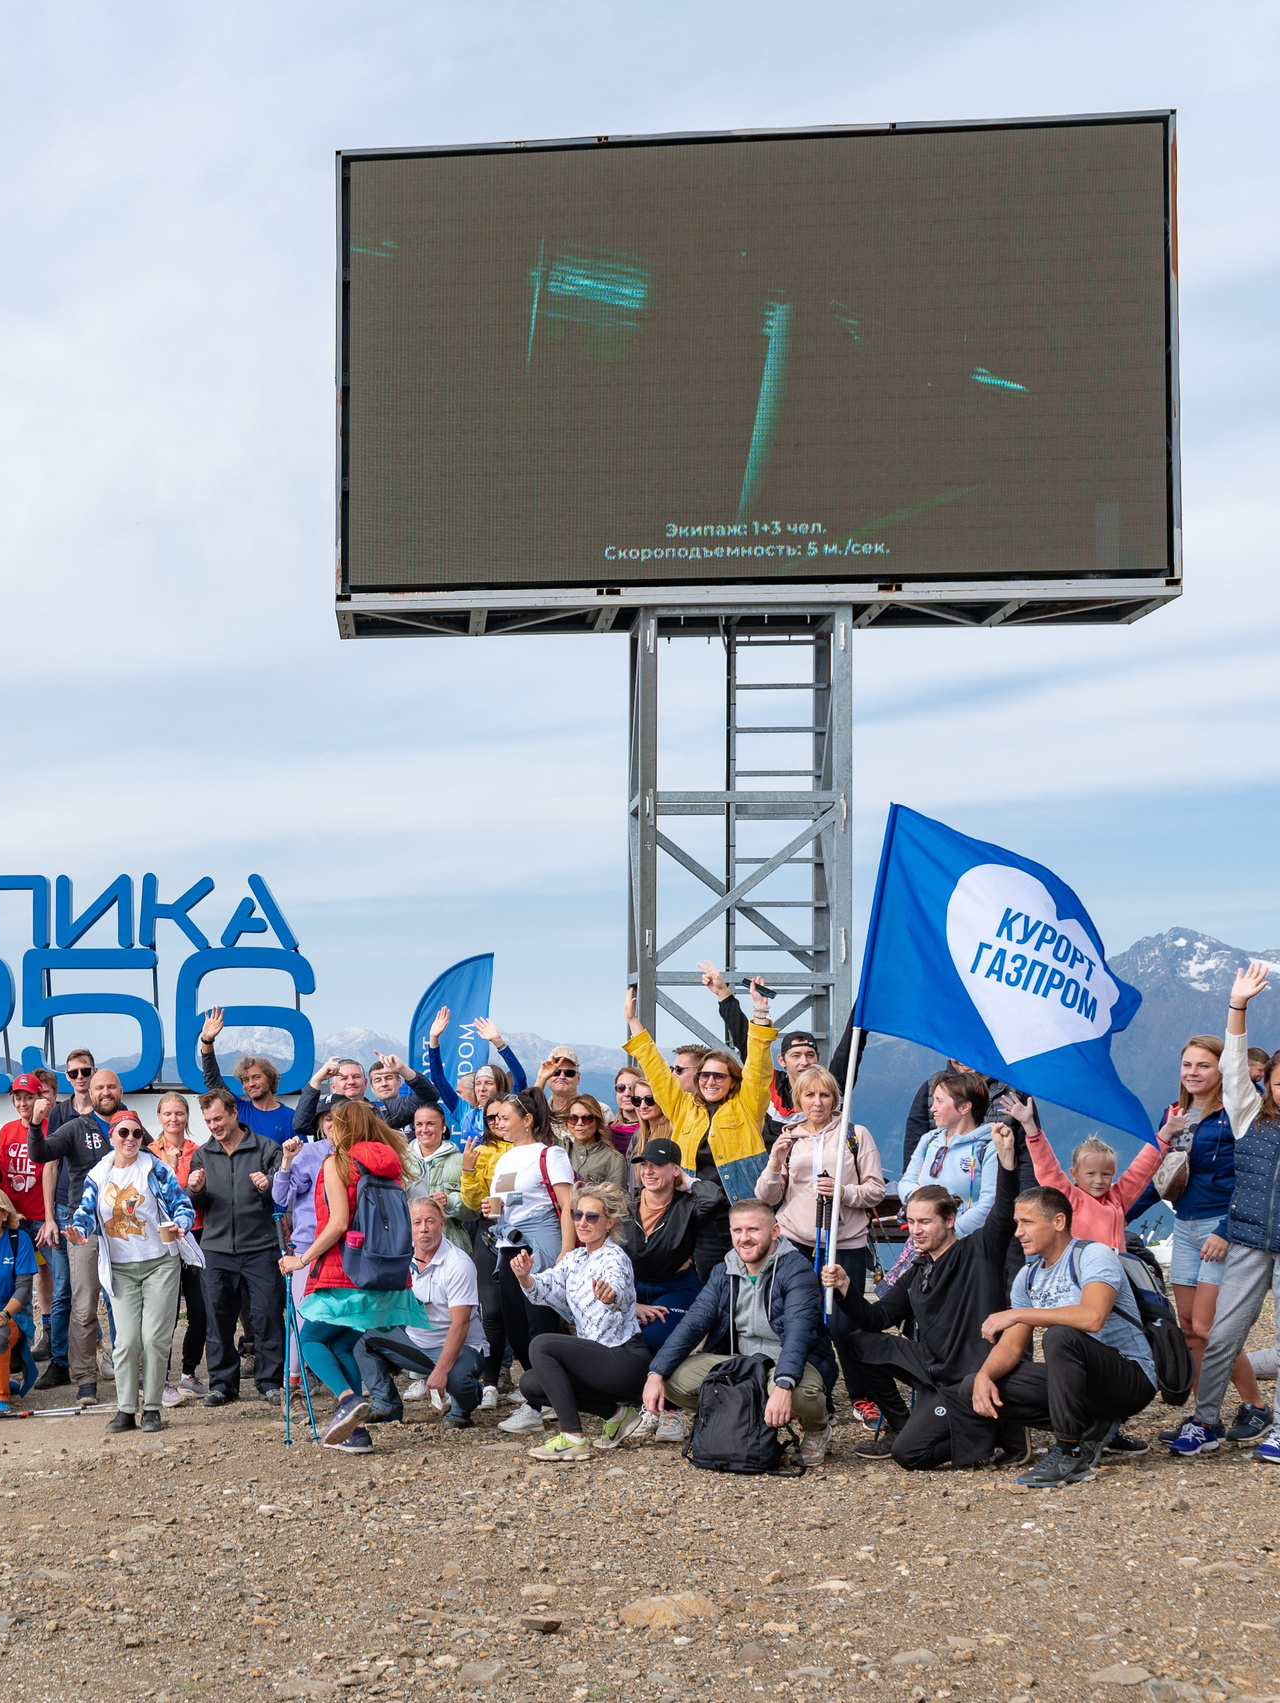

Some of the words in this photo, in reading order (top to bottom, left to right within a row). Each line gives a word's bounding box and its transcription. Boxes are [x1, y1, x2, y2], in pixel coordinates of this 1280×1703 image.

[665, 523, 748, 538] Экипаж:
[752, 521, 782, 535] 1+3
[786, 521, 827, 535] чел.
[807, 541, 818, 556] 5
[995, 907, 1097, 982] КУРОРТ
[970, 941, 1098, 1023] ГАЗПРОМ
[8, 1142, 30, 1158] СЕ
